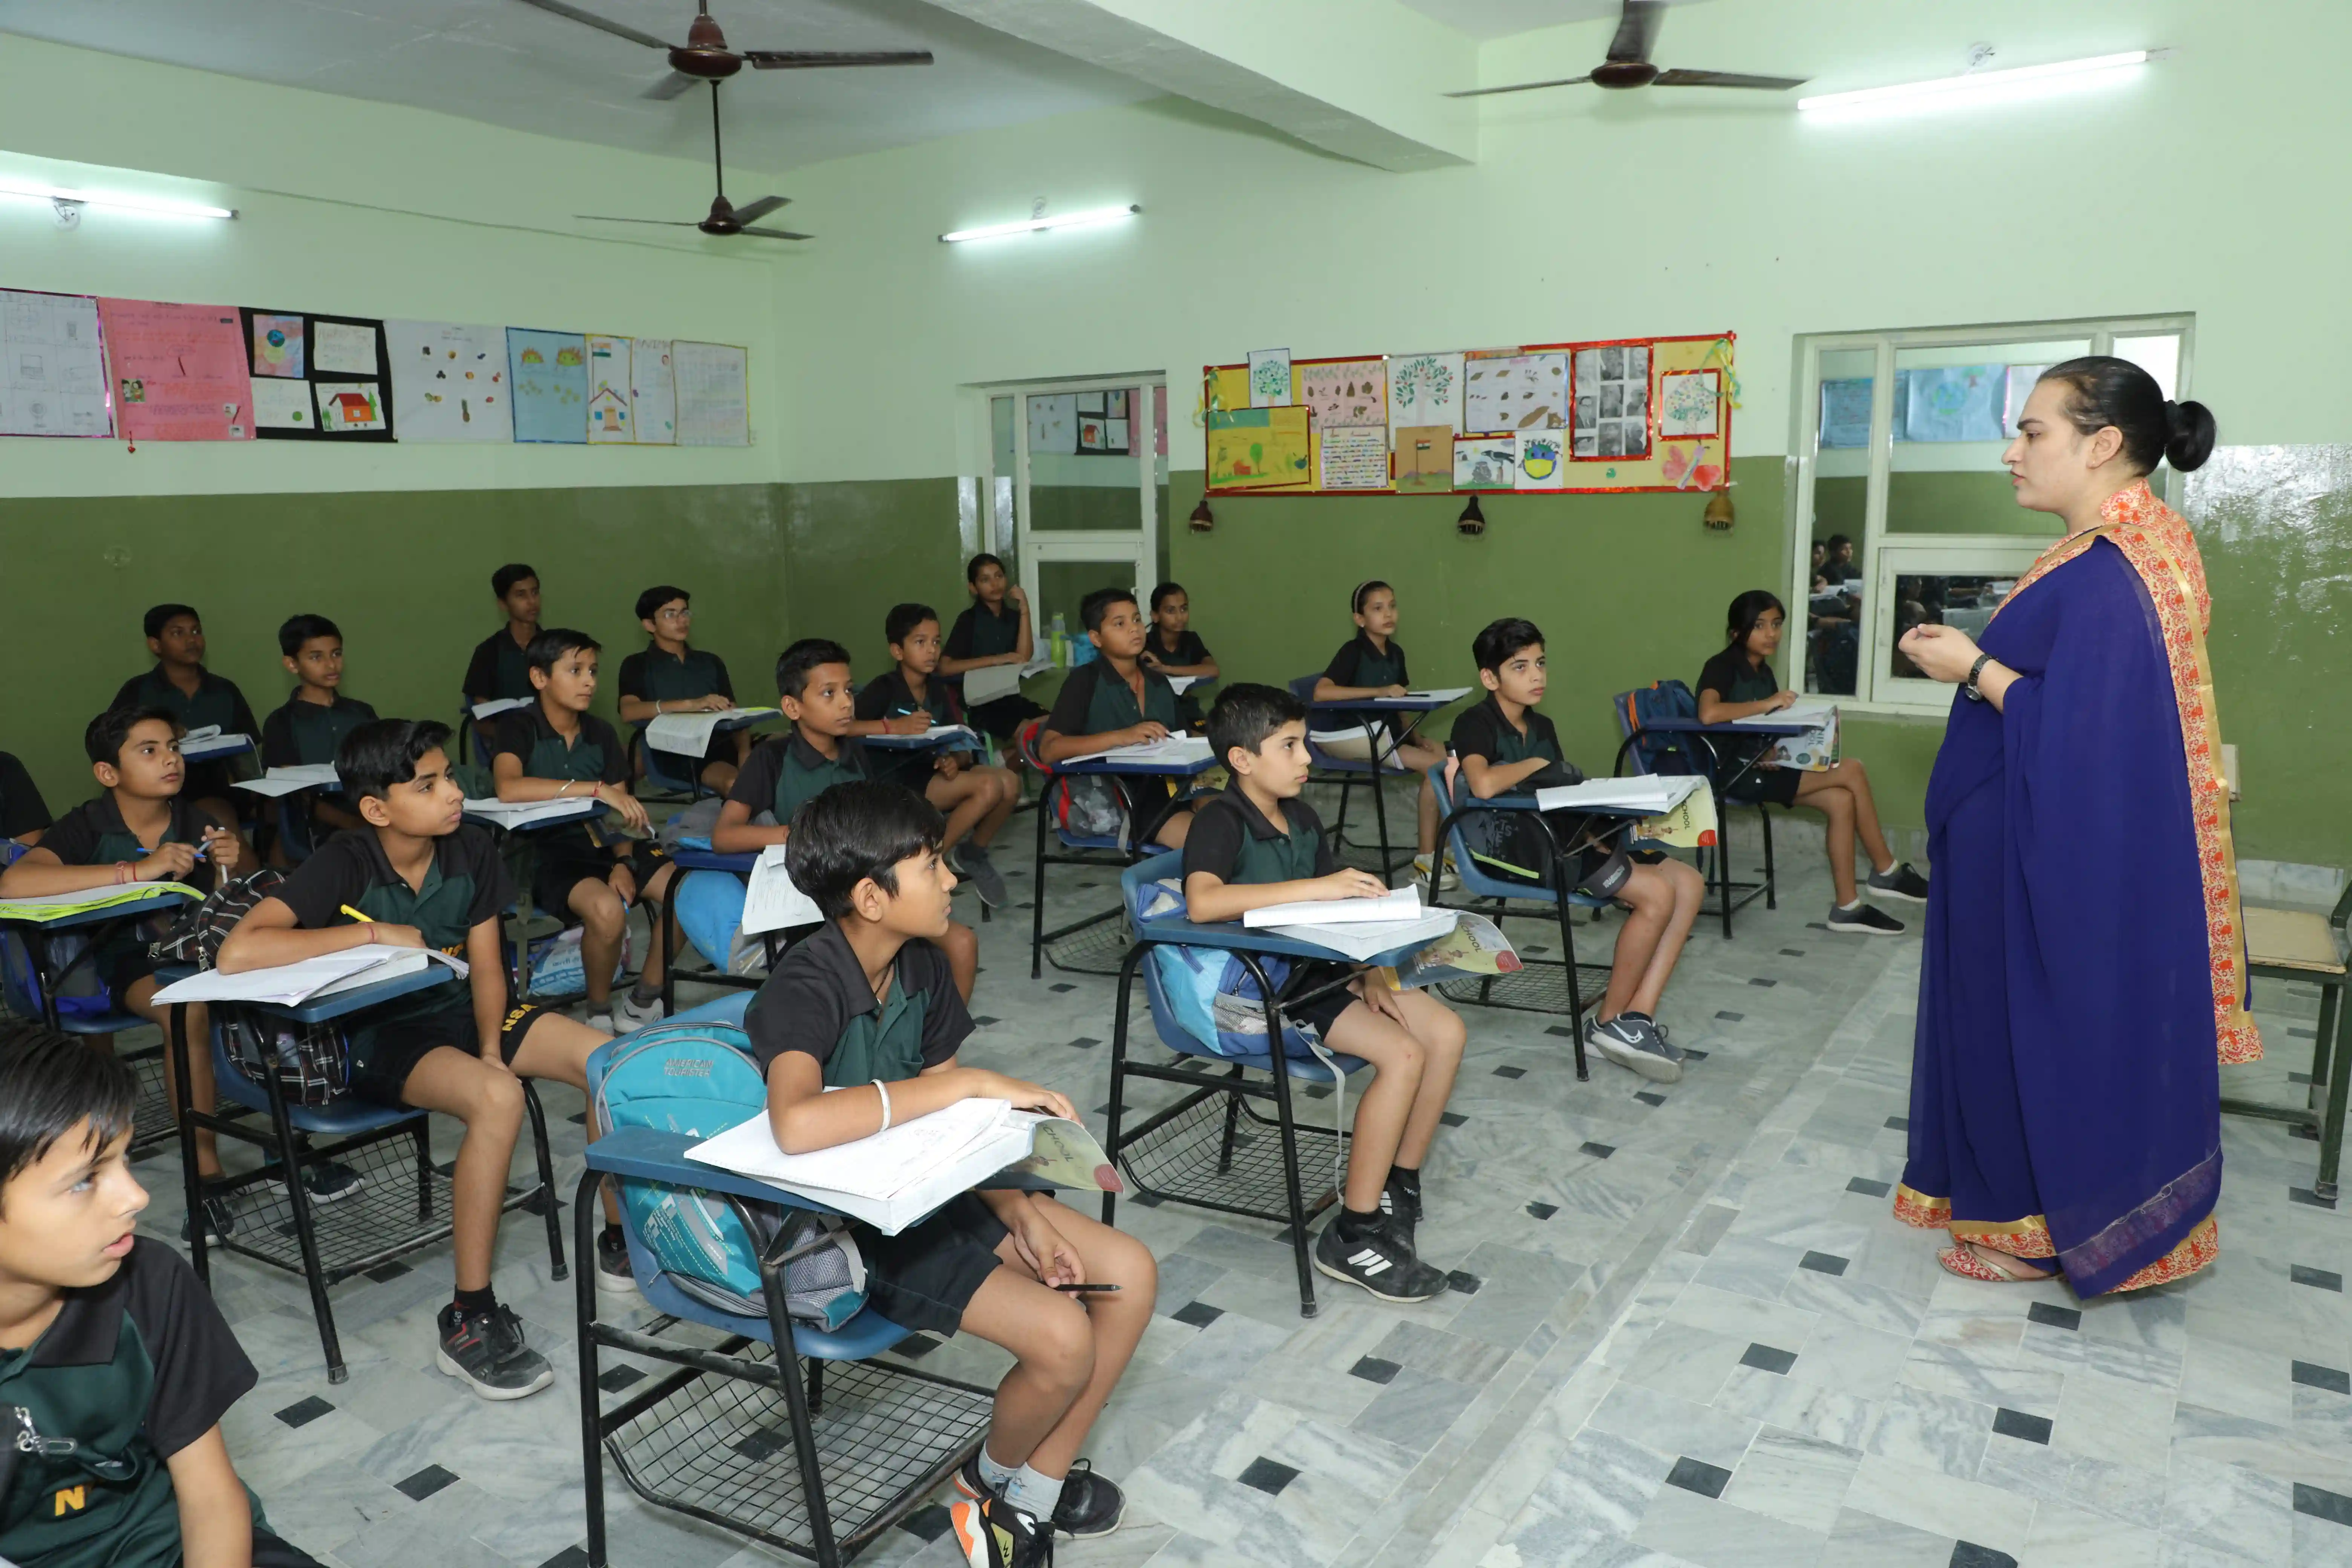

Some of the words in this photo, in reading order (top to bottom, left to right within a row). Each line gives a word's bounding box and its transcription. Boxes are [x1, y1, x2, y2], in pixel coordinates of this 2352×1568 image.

[1458, 922, 1482, 953] SCHOOL
[665, 1058, 714, 1068] AMERICAN
[664, 1067, 711, 1076] TOURISTER
